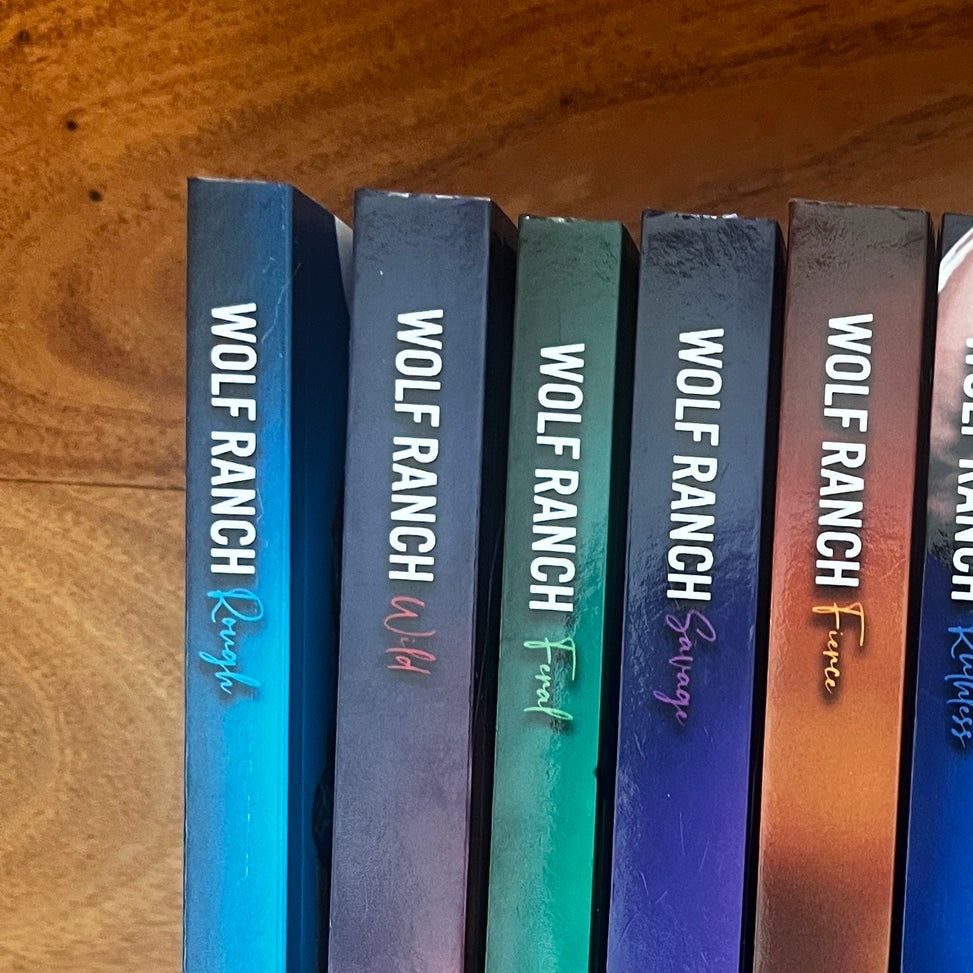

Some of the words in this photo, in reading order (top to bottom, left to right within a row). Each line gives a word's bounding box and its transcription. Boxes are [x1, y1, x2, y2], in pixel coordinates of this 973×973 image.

[210, 303, 257, 425] WOLF
[392, 309, 444, 428] WOLF
[535, 342, 586, 460] WOLF
[673, 328, 724, 447] WOLF
[822, 313, 873, 431] WOLF
[210, 431, 256, 576] RANCH
[388, 435, 439, 582] RANCH
[529, 468, 577, 612] RANCH
[666, 455, 718, 601] RANCH
[815, 439, 866, 587] RANCH
[199, 588, 262, 694] Rough
[388, 596, 437, 675] Wild
[522, 637, 577, 722] Feral
[652, 611, 716, 726] Savage
[813, 603, 865, 695] Fierce
